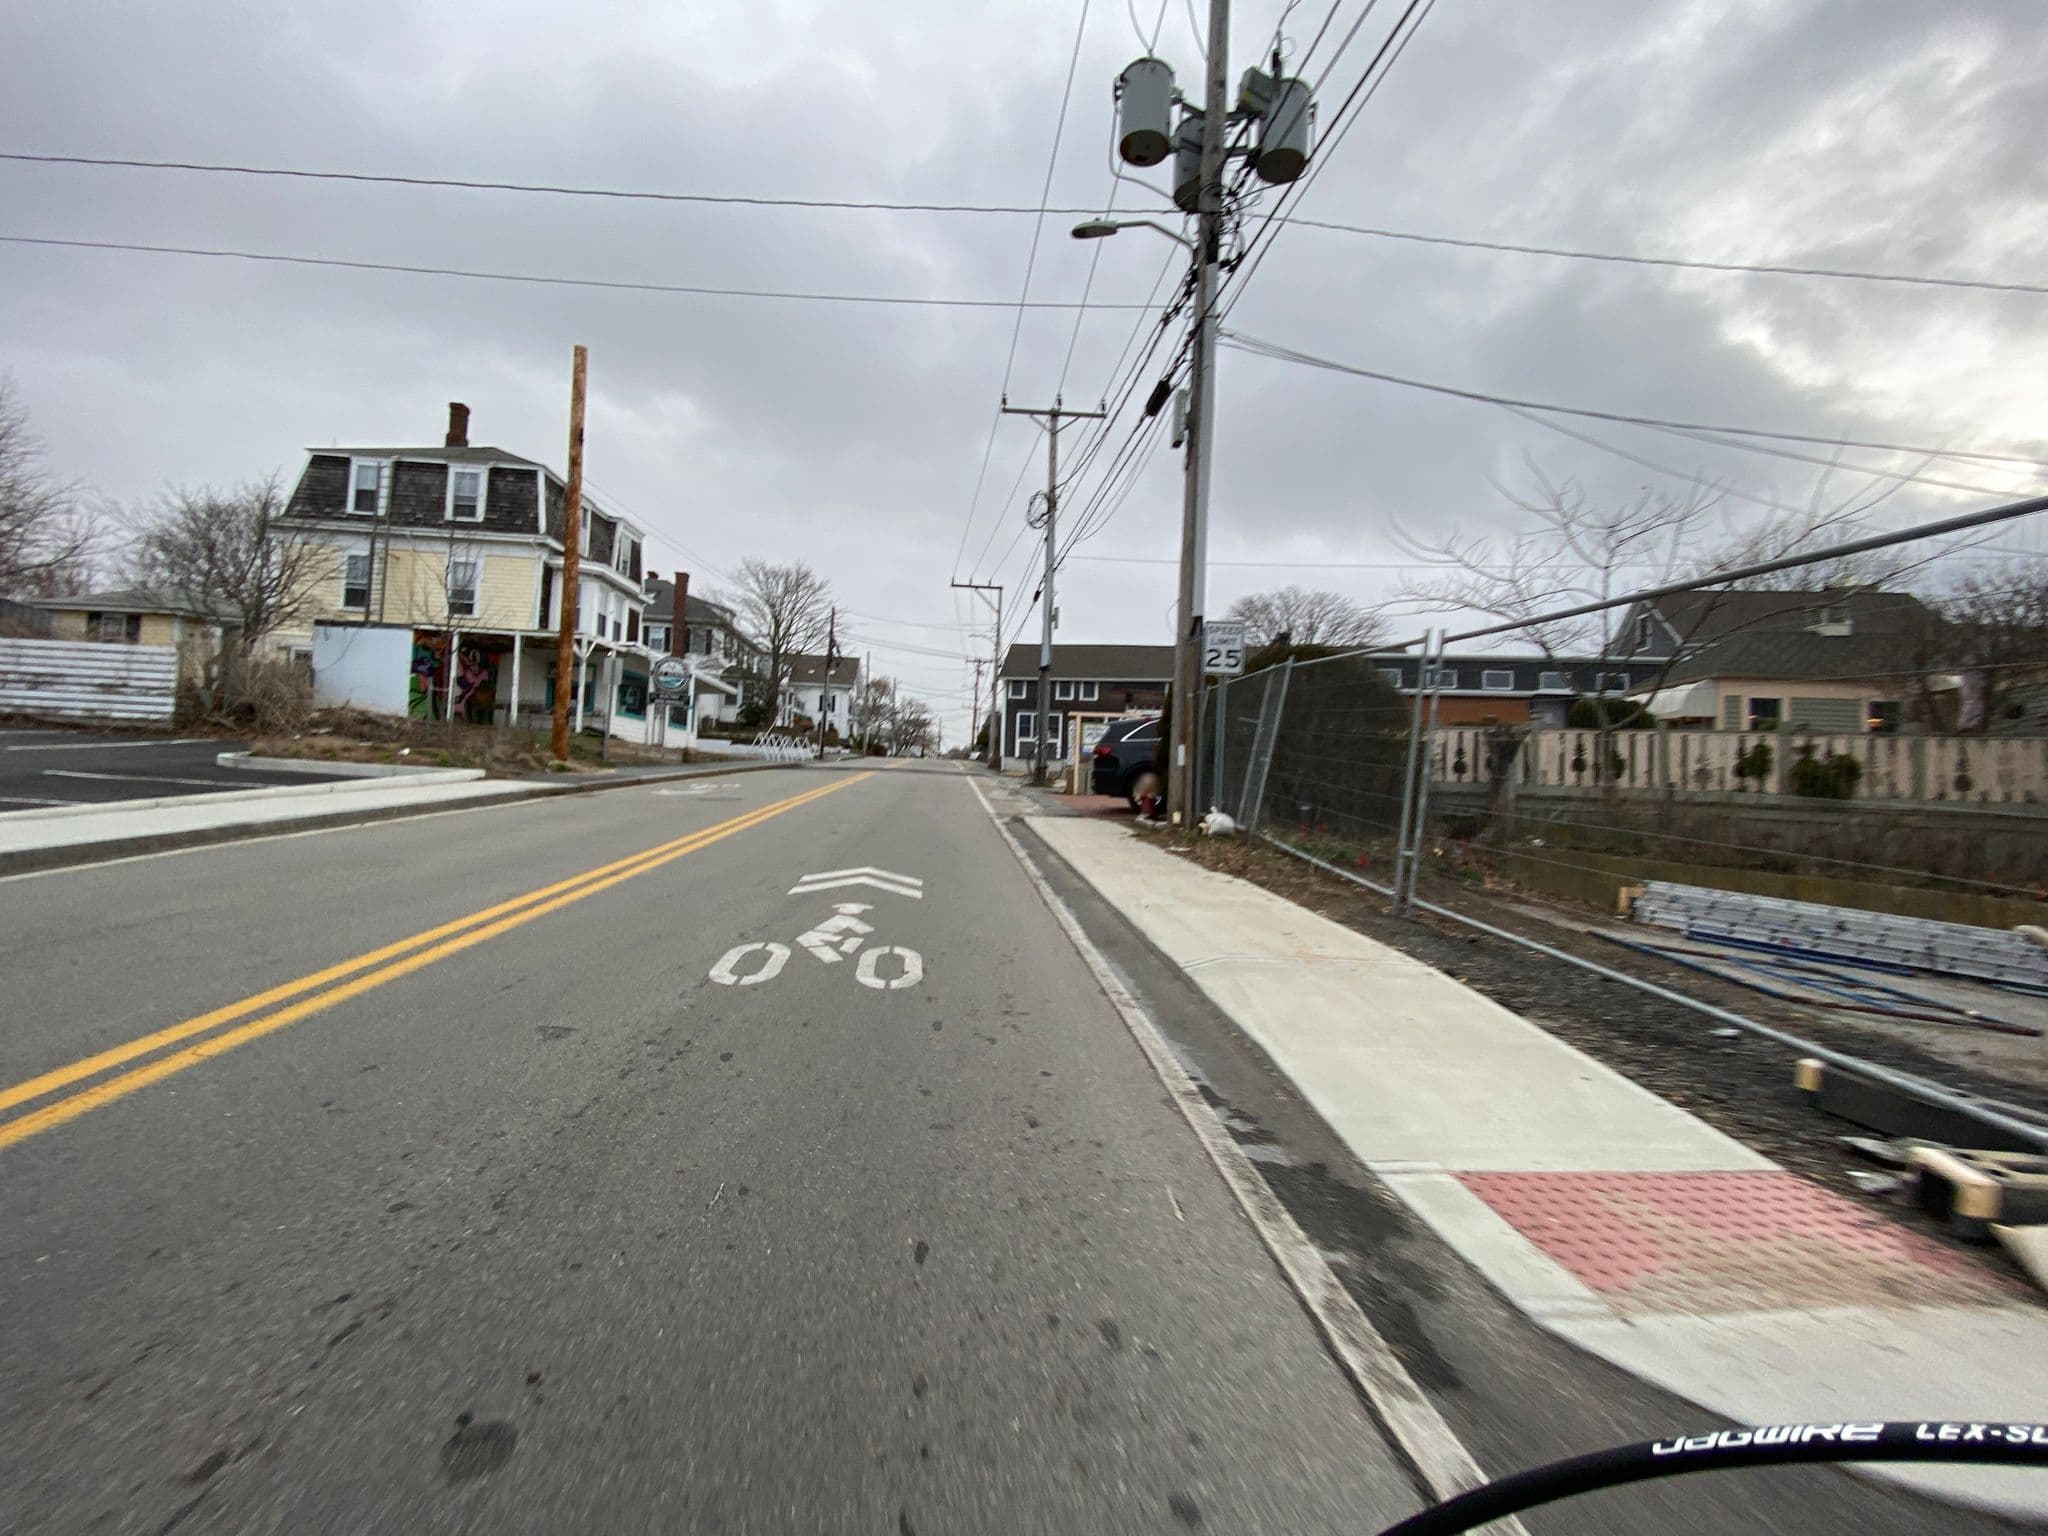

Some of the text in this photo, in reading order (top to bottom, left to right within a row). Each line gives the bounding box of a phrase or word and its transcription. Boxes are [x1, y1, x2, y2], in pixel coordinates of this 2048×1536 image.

[1207, 626, 1241, 635] SPEED
[1210, 637, 1238, 646] LIMIT
[1206, 648, 1241, 668] 25
[1916, 1423, 2048, 1444] LEX-SL
